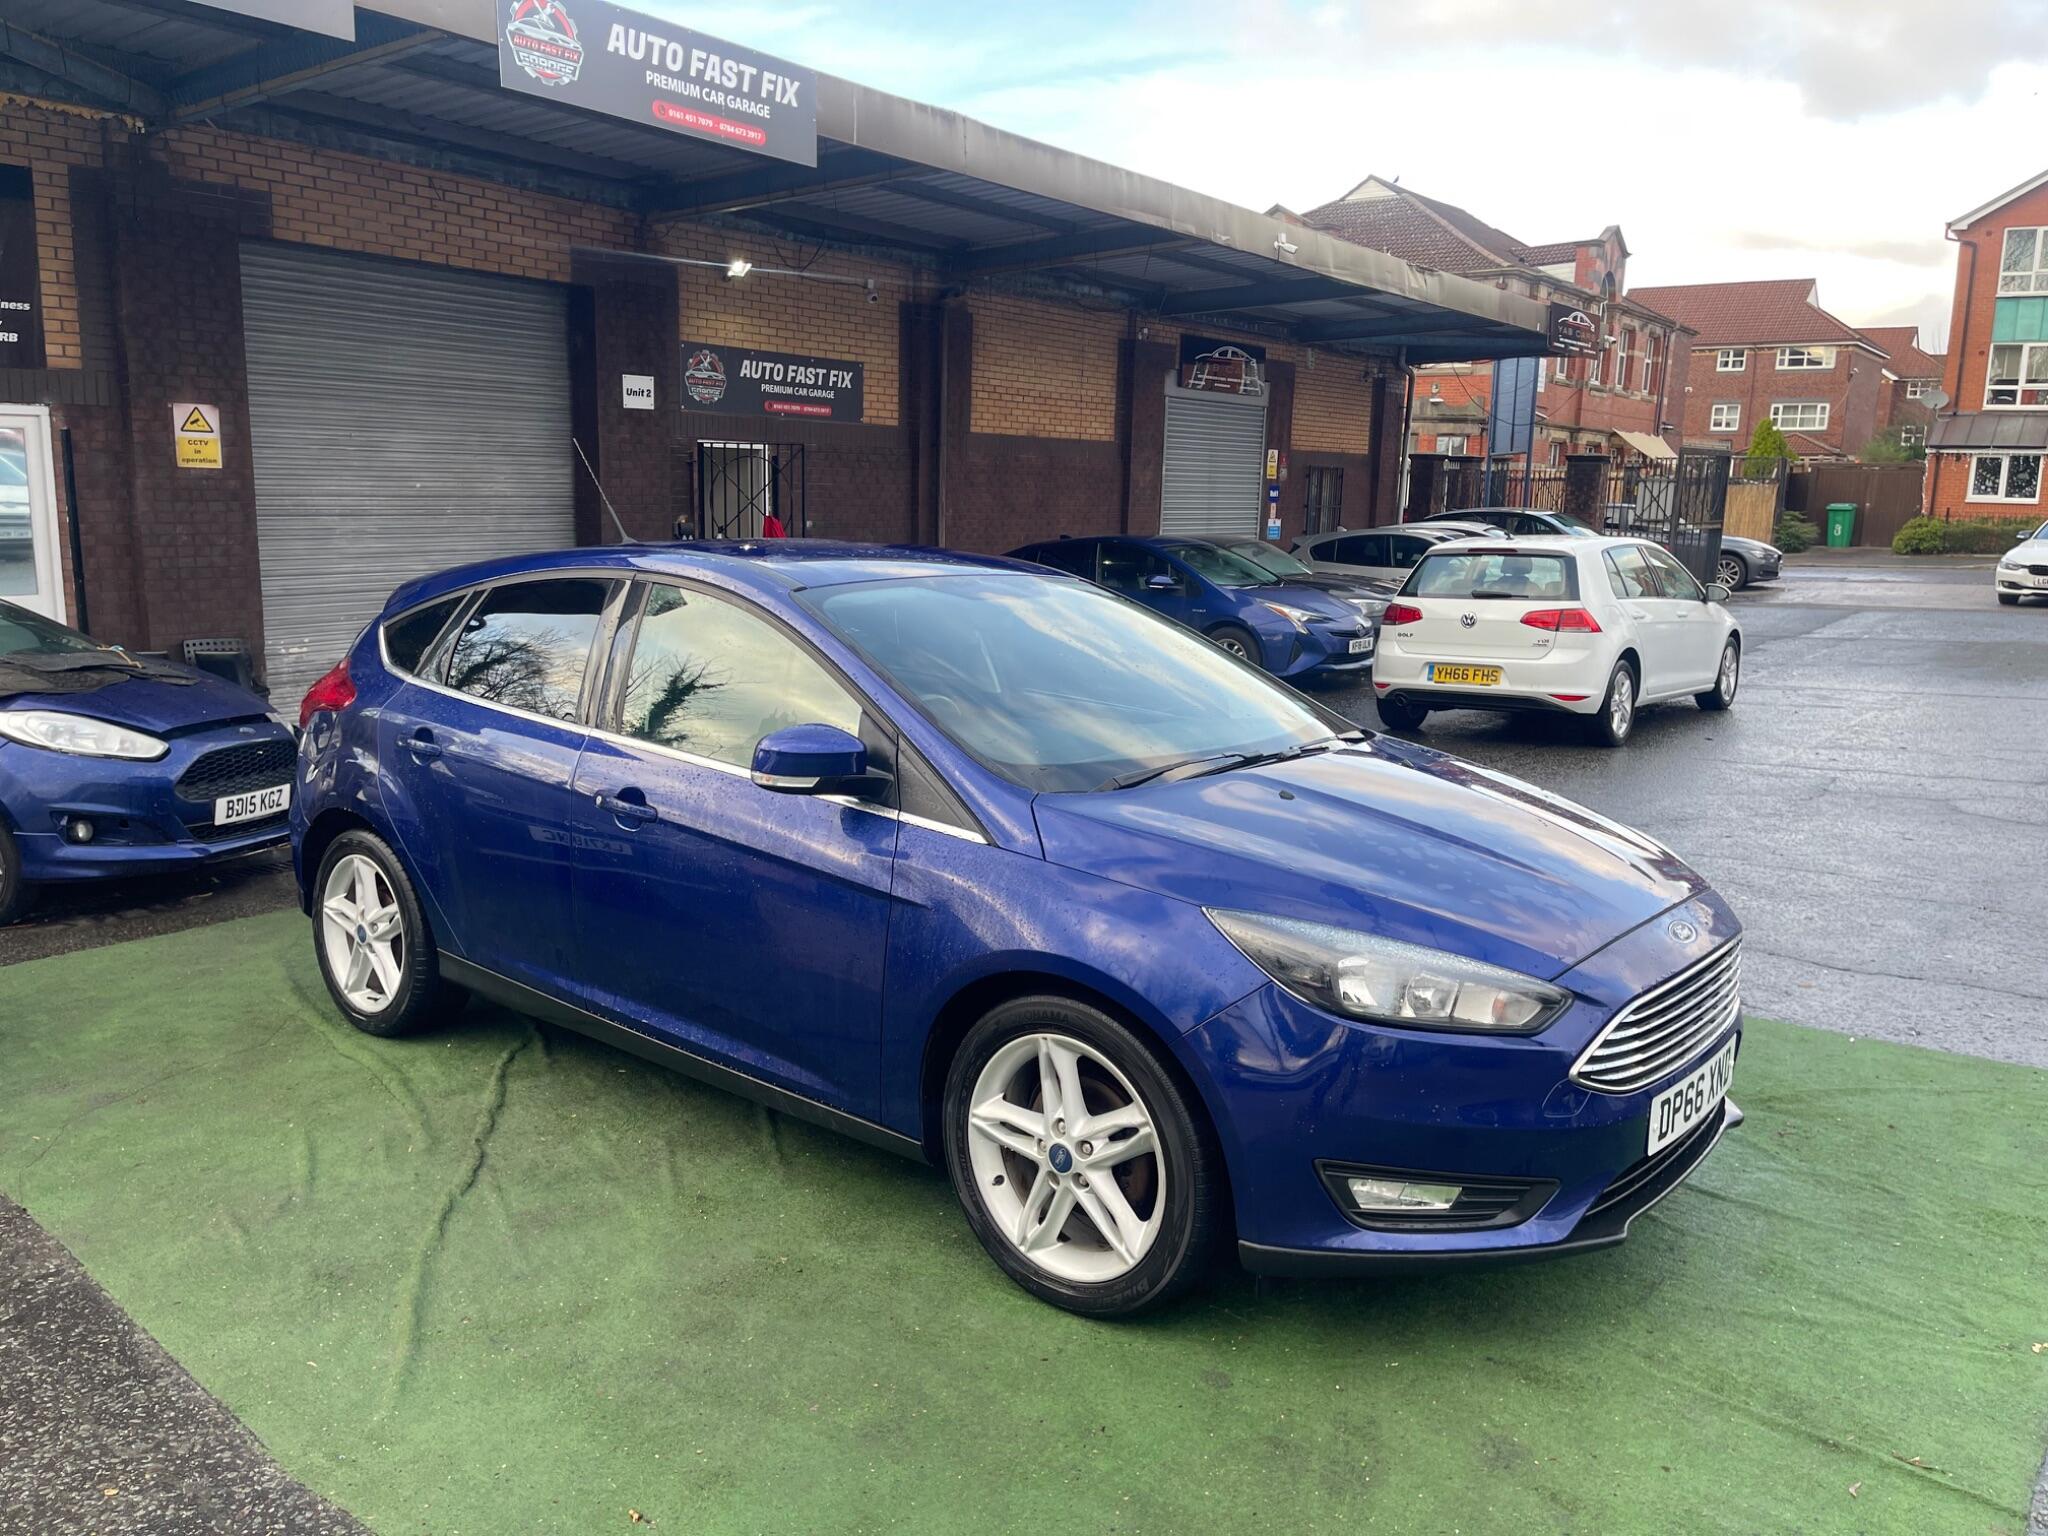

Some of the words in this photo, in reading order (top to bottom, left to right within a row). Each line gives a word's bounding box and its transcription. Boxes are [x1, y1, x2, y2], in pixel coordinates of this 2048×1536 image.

[513, 35, 539, 50] AUTO
[541, 42, 562, 55] FAST
[564, 50, 579, 62] FIX
[607, 23, 684, 72] AUTO
[690, 48, 757, 93] FAST
[760, 70, 801, 108] FIX
[646, 70, 701, 99] PREMIUM
[702, 88, 726, 106] CAR
[727, 95, 771, 119] GARAGE
[0, 300, 30, 310] ness
[739, 359, 784, 381] AUTO
[787, 365, 827, 385] FAST
[829, 370, 854, 388] FIX
[626, 387, 644, 397] Unit
[646, 389, 652, 398] 2
[761, 383, 793, 395] PREMIUM
[794, 387, 808, 396] CAR
[808, 388, 835, 399] GARAGE
[1436, 667, 1469, 681] YH66
[1472, 669, 1499, 683] FHS
[225, 795, 257, 819] BD15
[260, 788, 283, 812] KGZ
[1657, 1073, 1705, 1143] DP66
